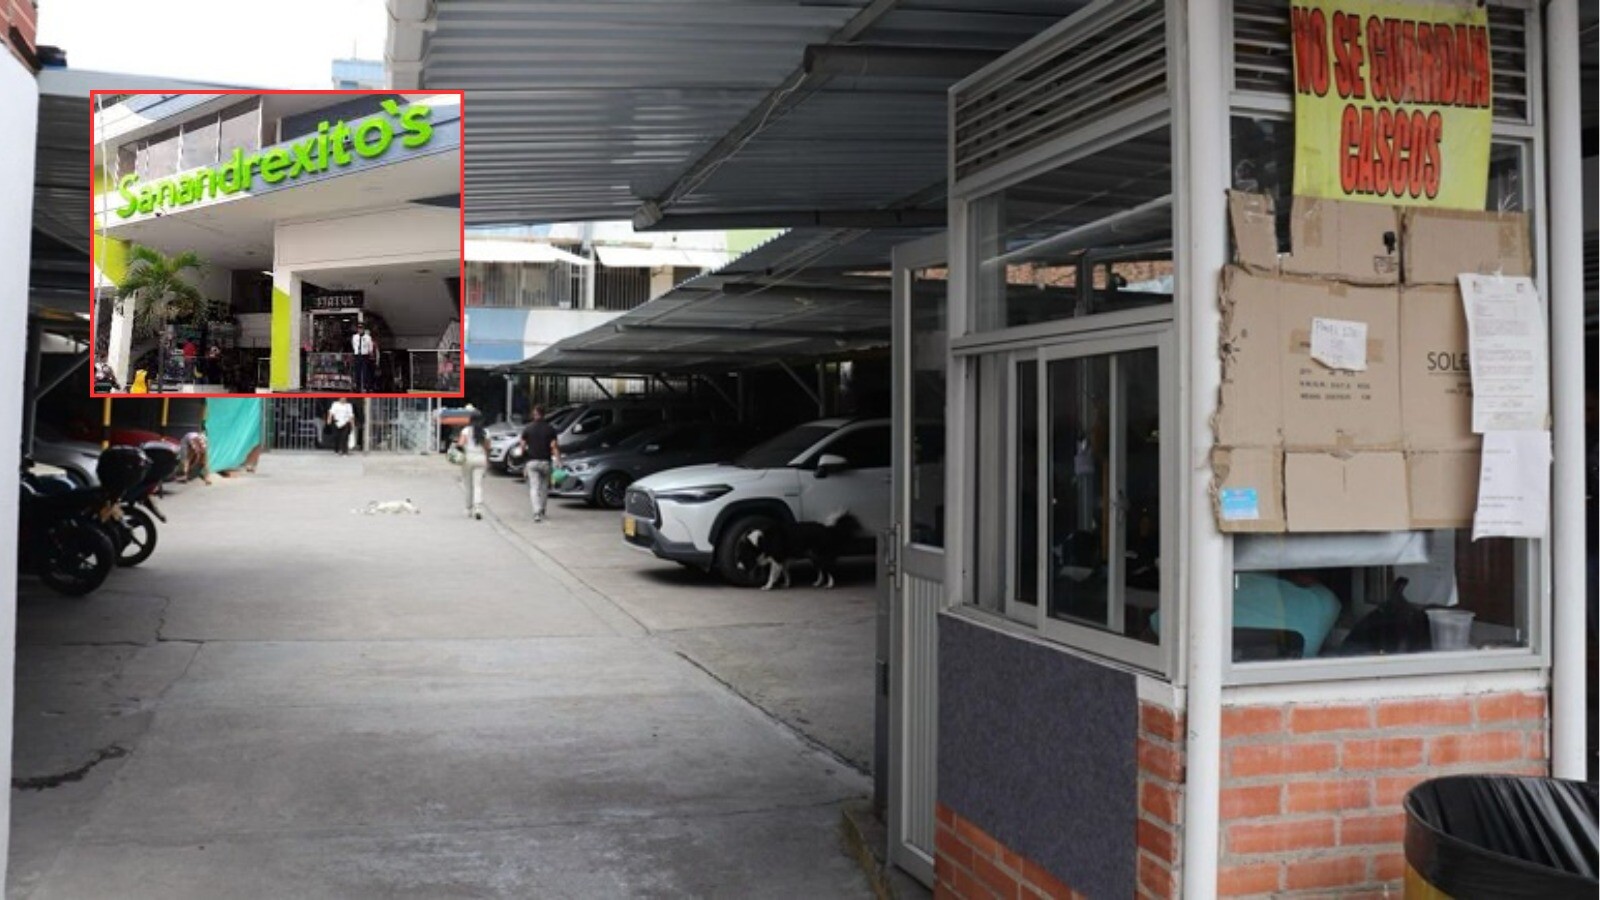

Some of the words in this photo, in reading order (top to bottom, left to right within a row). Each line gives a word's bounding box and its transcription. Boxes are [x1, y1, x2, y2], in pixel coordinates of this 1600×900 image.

[1293, 6, 1329, 97] NO
[1332, 10, 1365, 99] SE
[1366, 15, 1490, 109] GUARDAN
[1340, 103, 1442, 199] CASCOS
